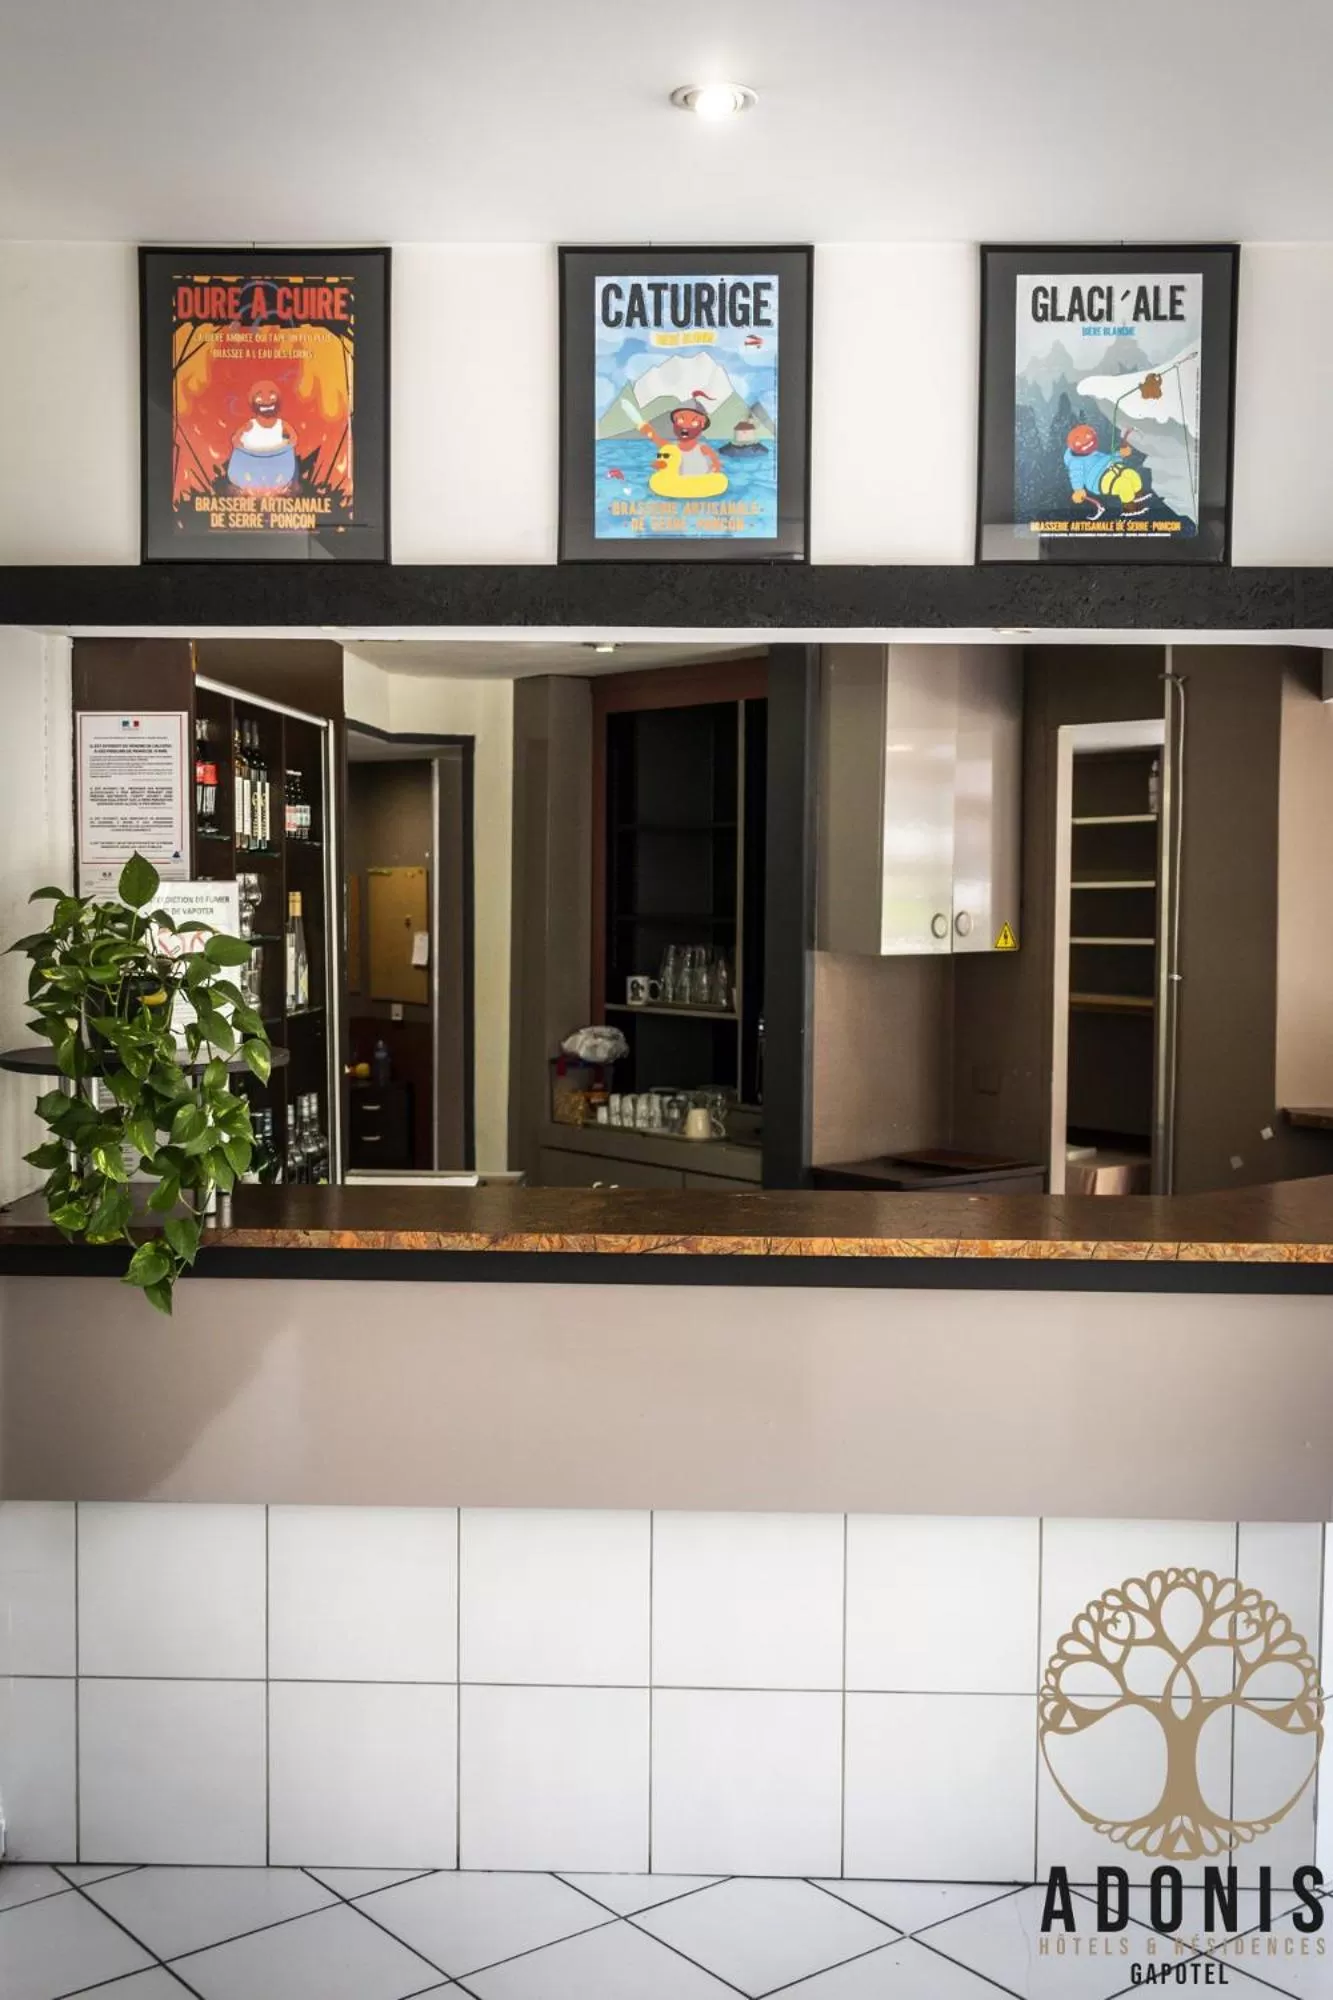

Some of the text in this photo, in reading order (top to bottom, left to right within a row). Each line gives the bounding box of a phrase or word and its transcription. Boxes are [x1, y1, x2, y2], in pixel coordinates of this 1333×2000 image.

[177, 286, 242, 320] DURE
[276, 286, 349, 321] CUIRE
[195, 496, 332, 513] BRASSERIE ARTISANALE
[210, 513, 225, 527] DE
